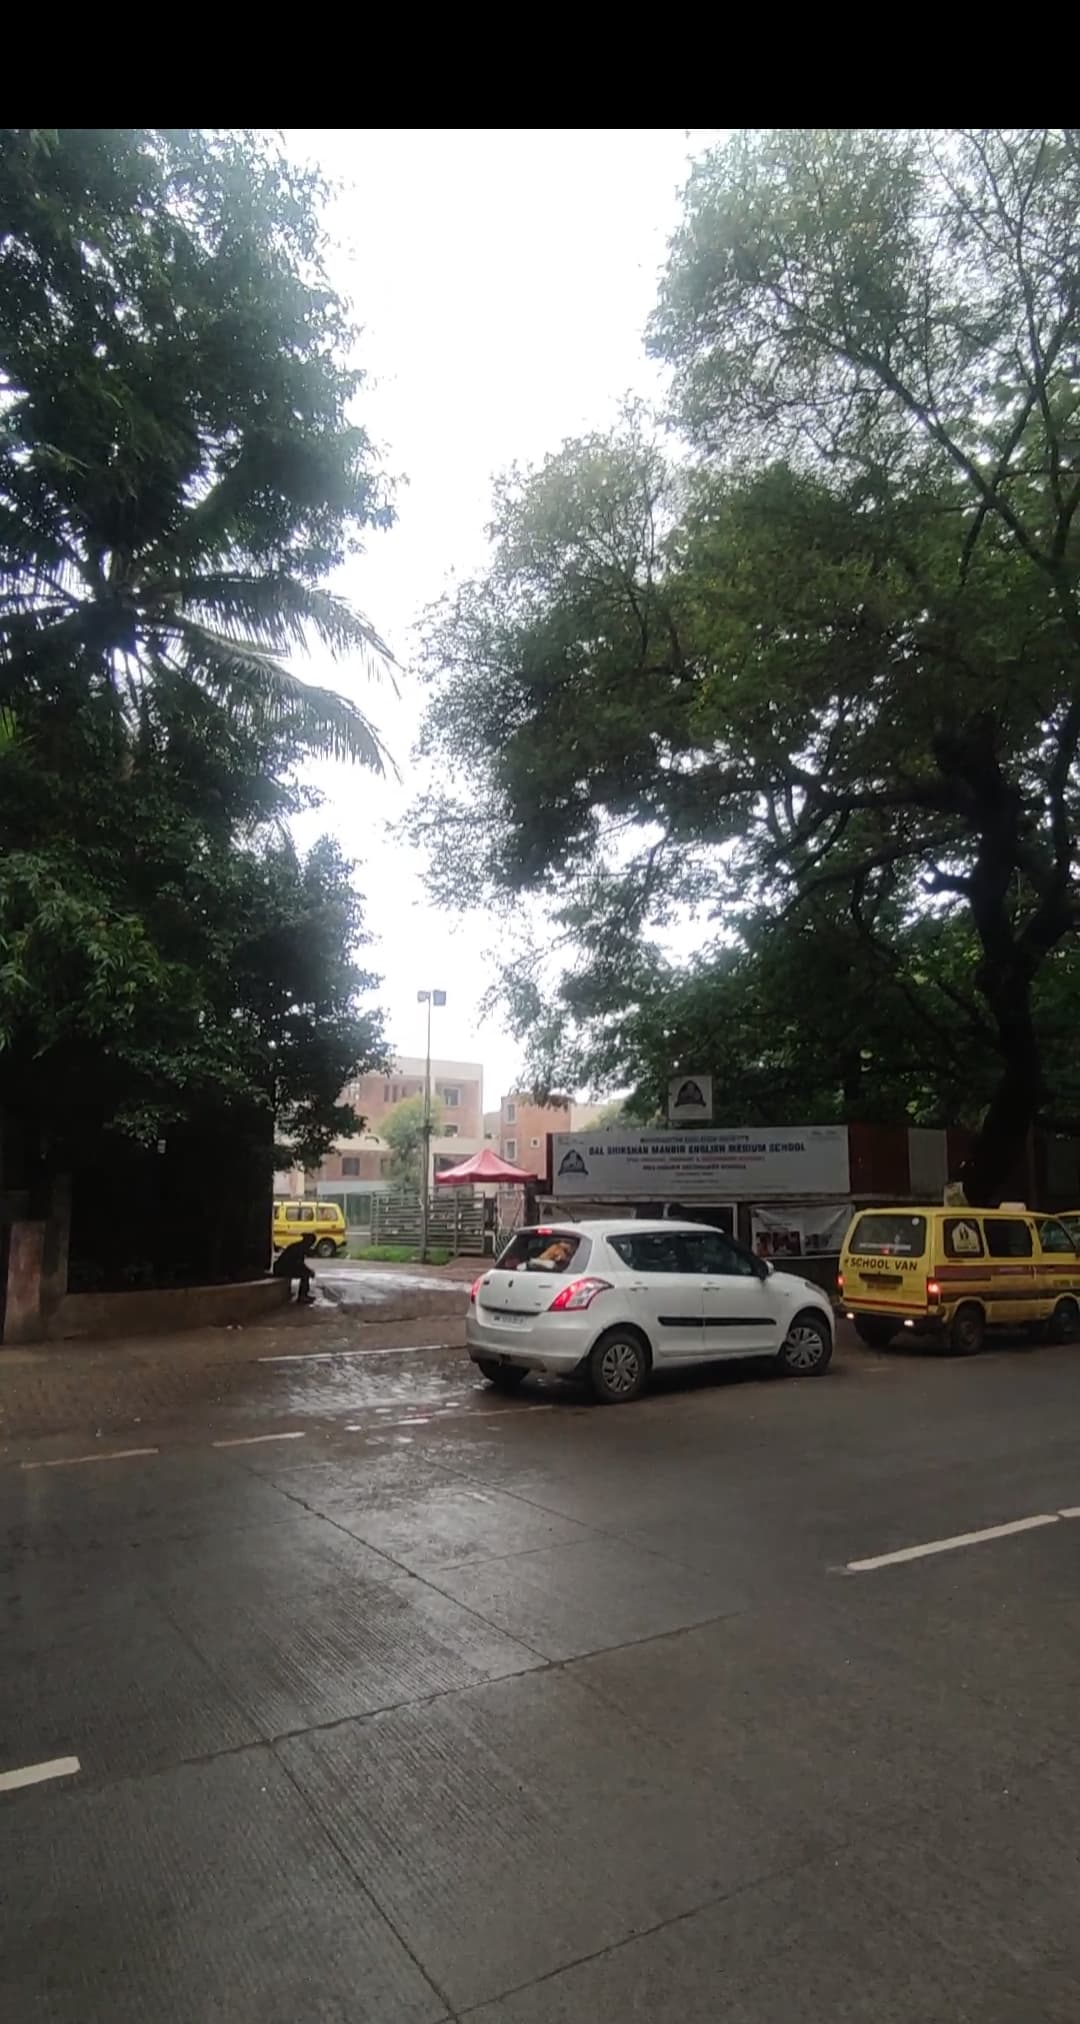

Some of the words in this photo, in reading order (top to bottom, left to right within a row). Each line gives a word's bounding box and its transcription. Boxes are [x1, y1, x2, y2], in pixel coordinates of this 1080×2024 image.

[688, 1144, 725, 1154] ENGLISH
[727, 1143, 766, 1153] MEDIUM
[769, 1142, 806, 1153] SCHOOL
[850, 1257, 890, 1270] SCHOOL
[895, 1260, 918, 1271] VAN
